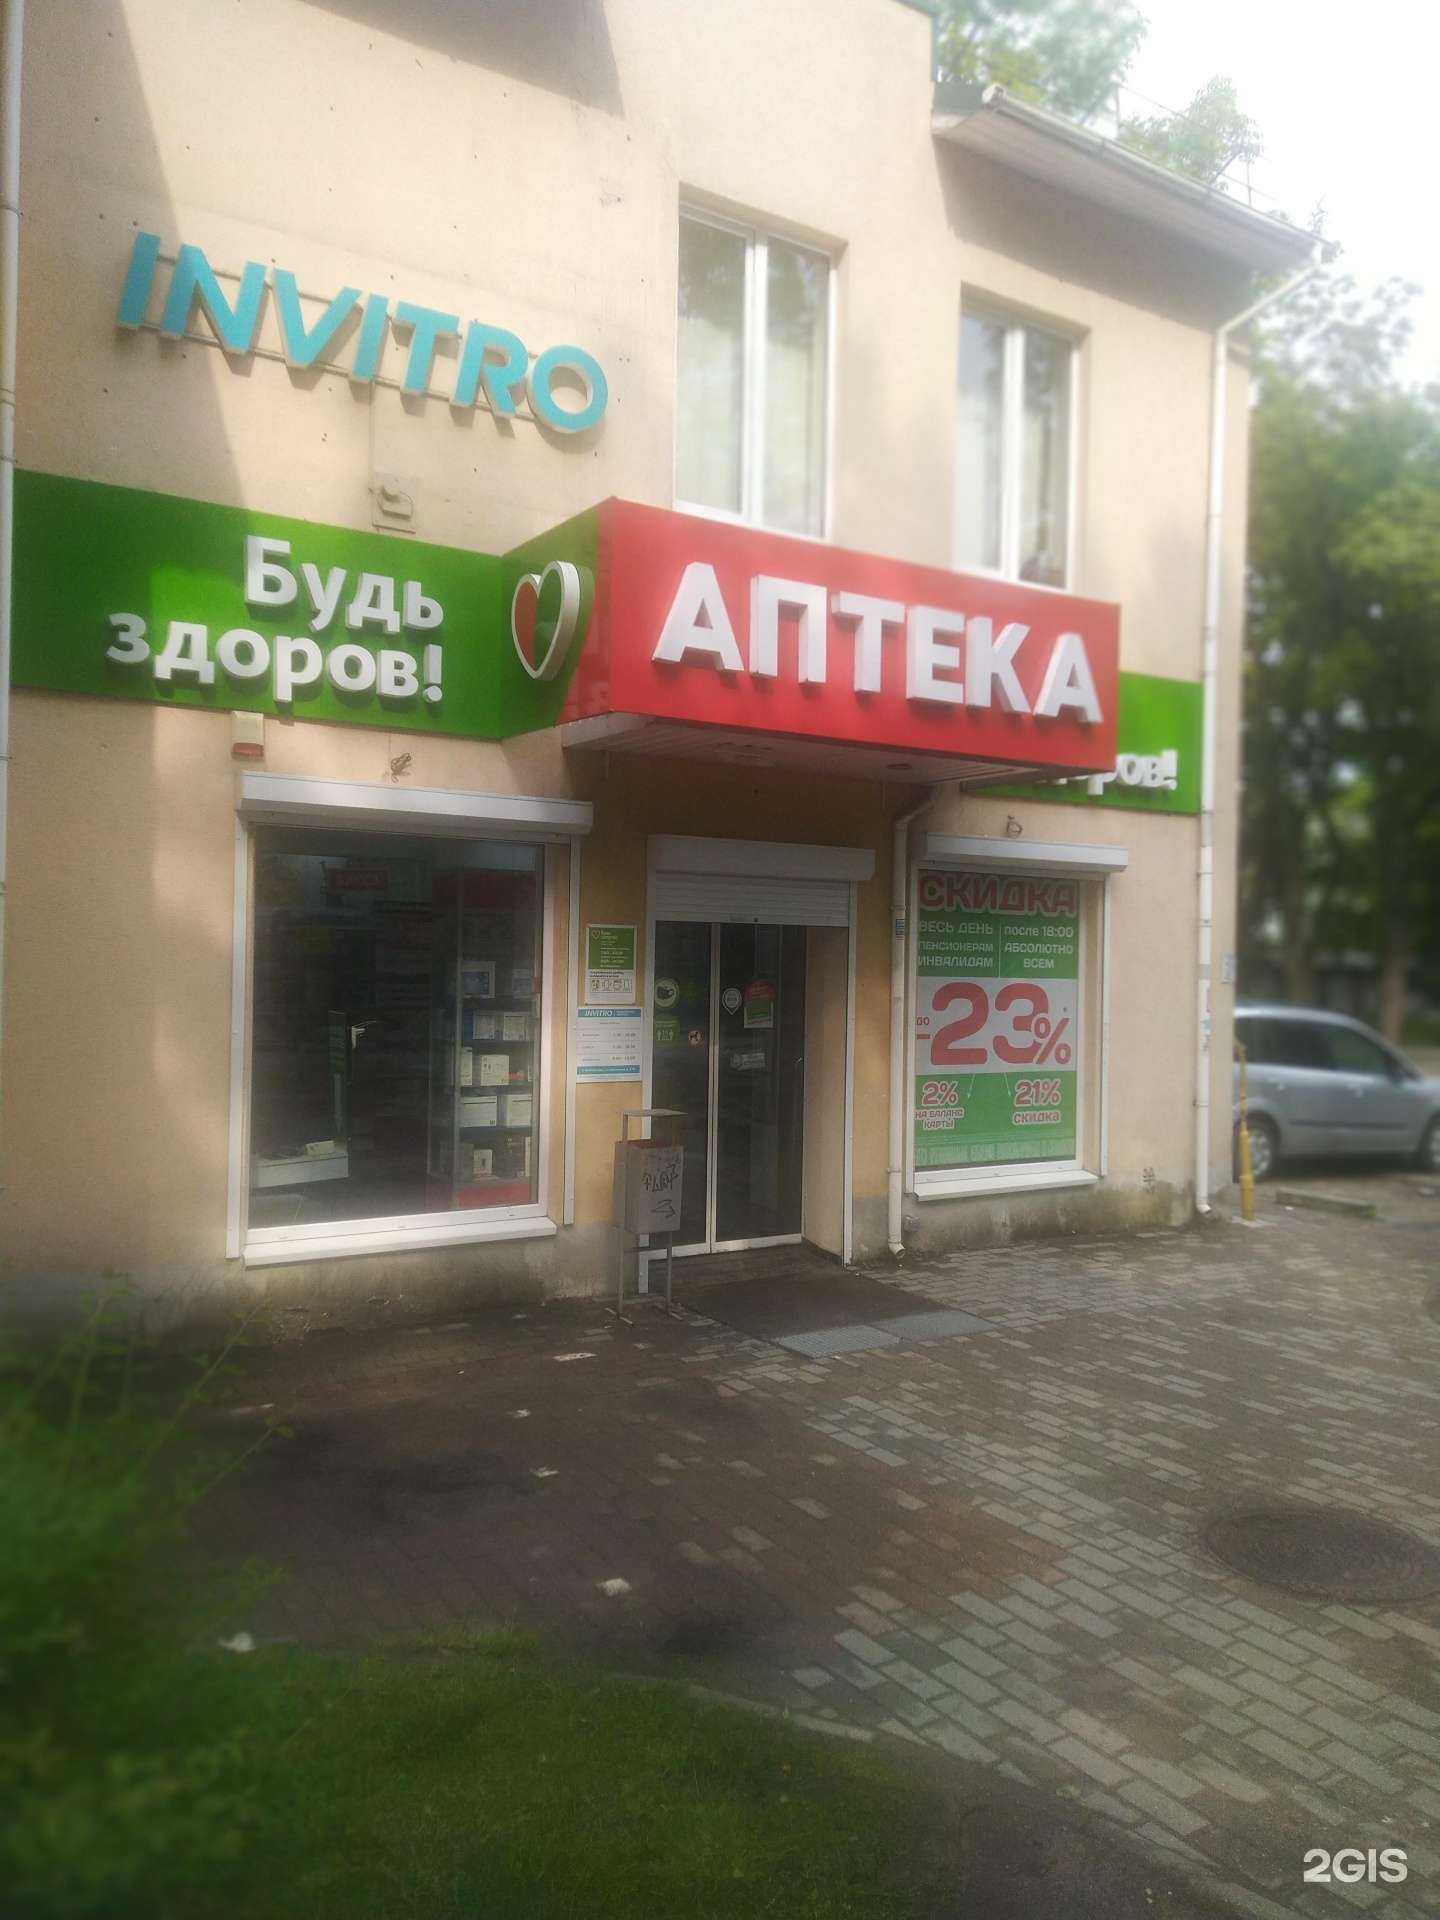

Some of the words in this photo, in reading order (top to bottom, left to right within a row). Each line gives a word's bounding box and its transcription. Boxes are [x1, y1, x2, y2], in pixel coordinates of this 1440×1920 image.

[116, 230, 609, 433] INVITRO
[244, 534, 444, 634] Будь
[652, 561, 1103, 724] АПТЕКА
[106, 611, 444, 704] здоров!
[918, 872, 1078, 917] СКИДКА
[919, 920, 954, 935] ВЕСЬ
[958, 921, 994, 935] ДЕНЬ
[1004, 926, 1040, 937] после
[1043, 926, 1074, 938] 18:00
[918, 941, 994, 953] ПЕНСИОНЕРАМ
[1004, 942, 1074, 954] АБСОЛЮТНО
[917, 956, 994, 968] ИНВАЛИДАМ
[1023, 958, 1056, 969] ВСЕМ
[922, 1080, 959, 1106] 2%
[1015, 1078, 1062, 1107] 21%
[924, 1118, 955, 1129] КАРТЫ
